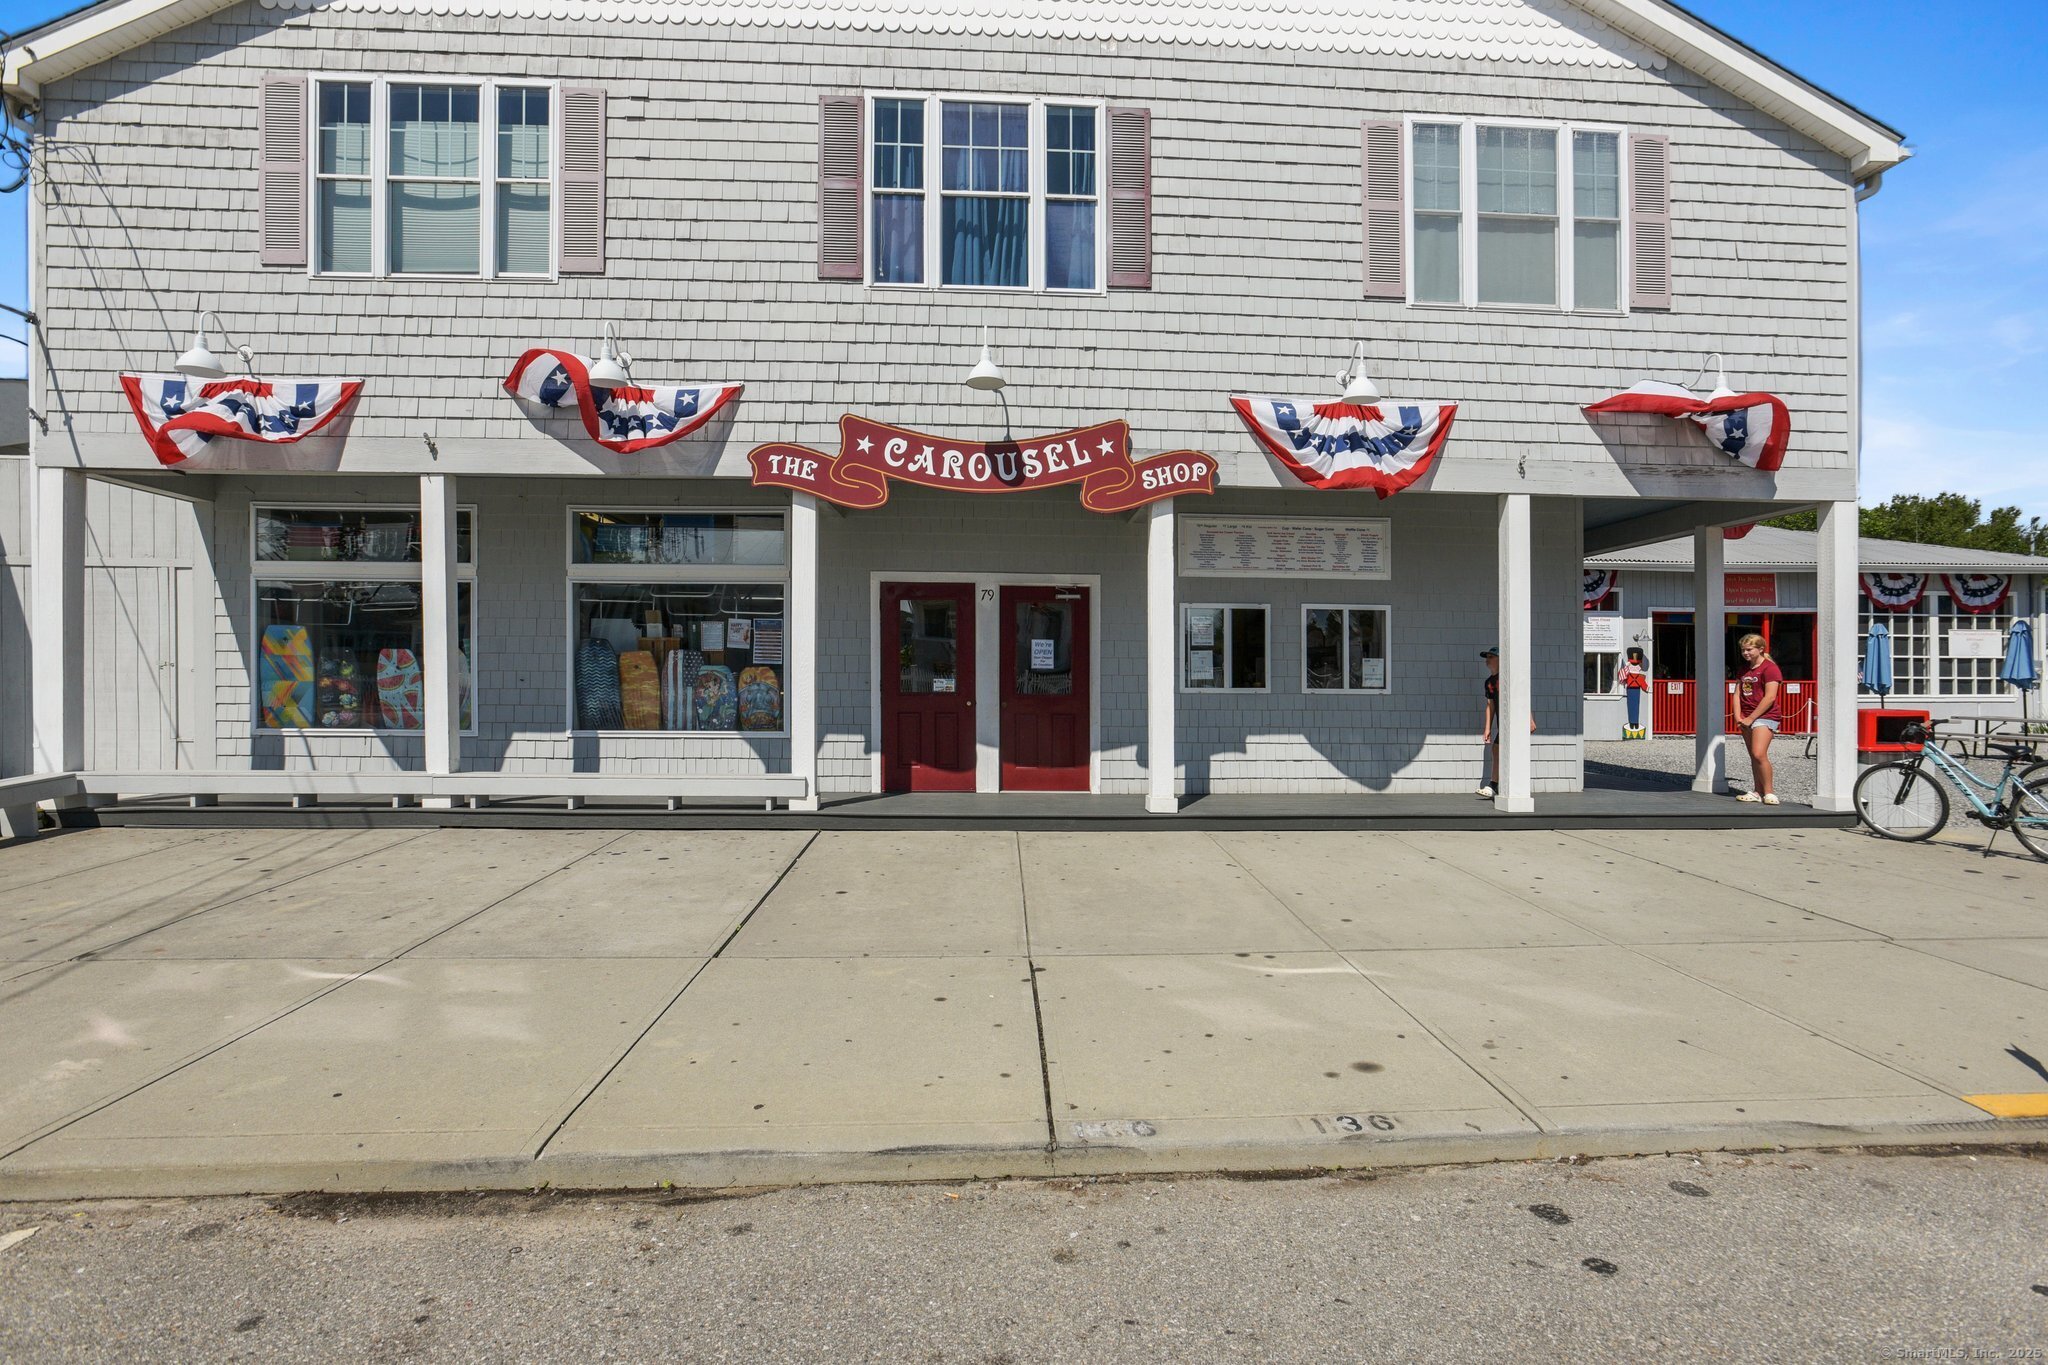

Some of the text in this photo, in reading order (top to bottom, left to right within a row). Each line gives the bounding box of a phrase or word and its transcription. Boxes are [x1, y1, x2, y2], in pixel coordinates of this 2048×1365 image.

[768, 438, 1208, 490] THE CAROUSEL SHOP
[981, 589, 995, 600] 79
[1671, 683, 1681, 691] EXIT
